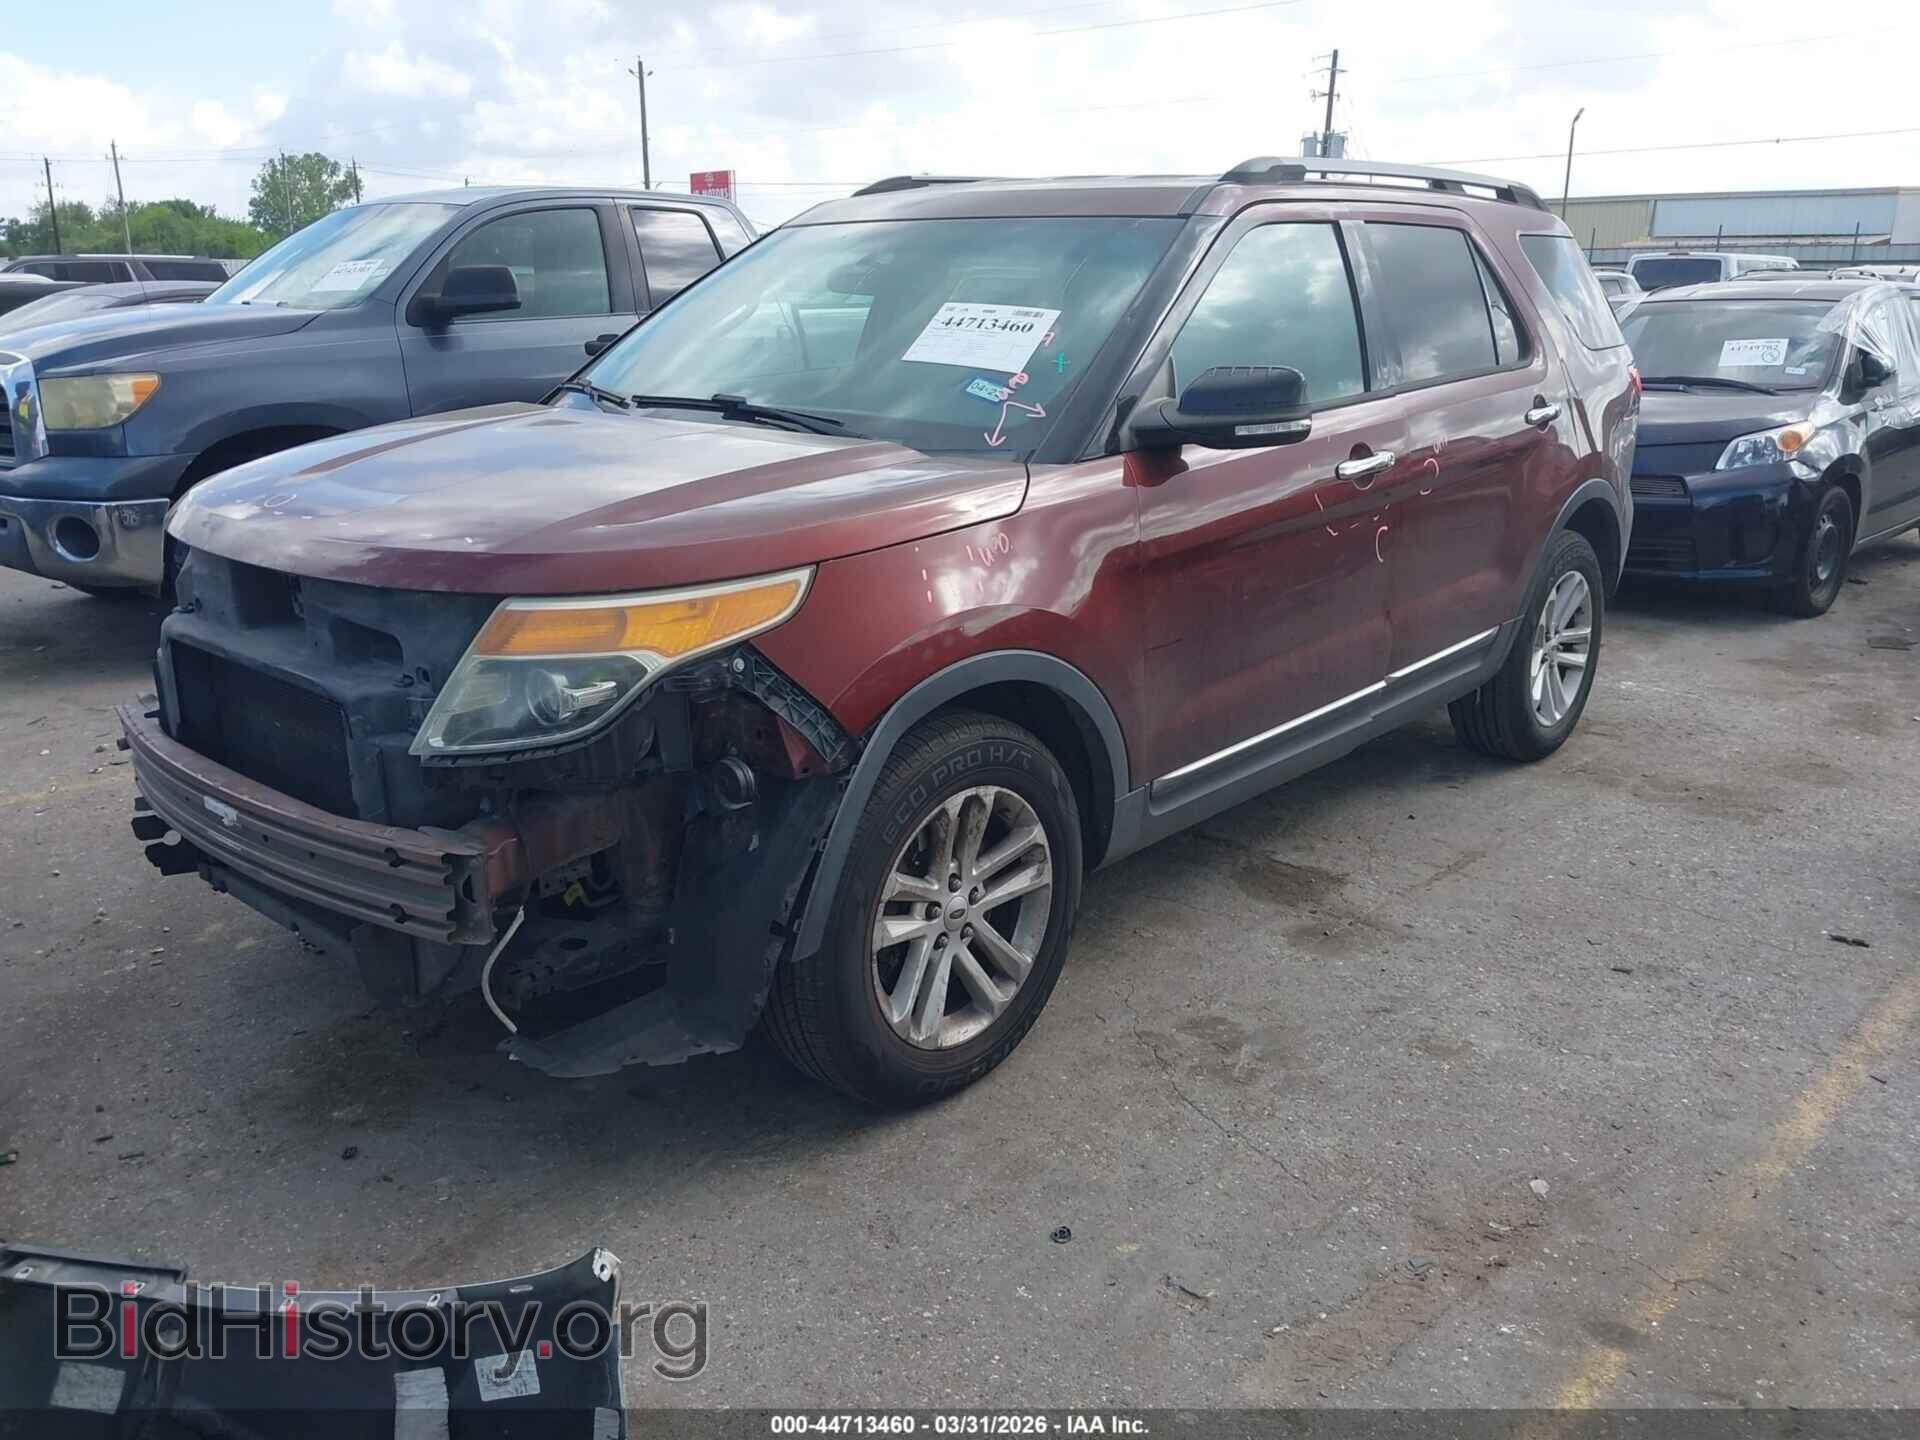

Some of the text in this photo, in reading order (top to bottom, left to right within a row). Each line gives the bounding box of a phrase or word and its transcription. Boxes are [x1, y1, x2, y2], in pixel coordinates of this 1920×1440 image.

[941, 315, 1034, 334] 44713460
[931, 748, 982, 786] PRO
[990, 745, 1032, 769] H/T
